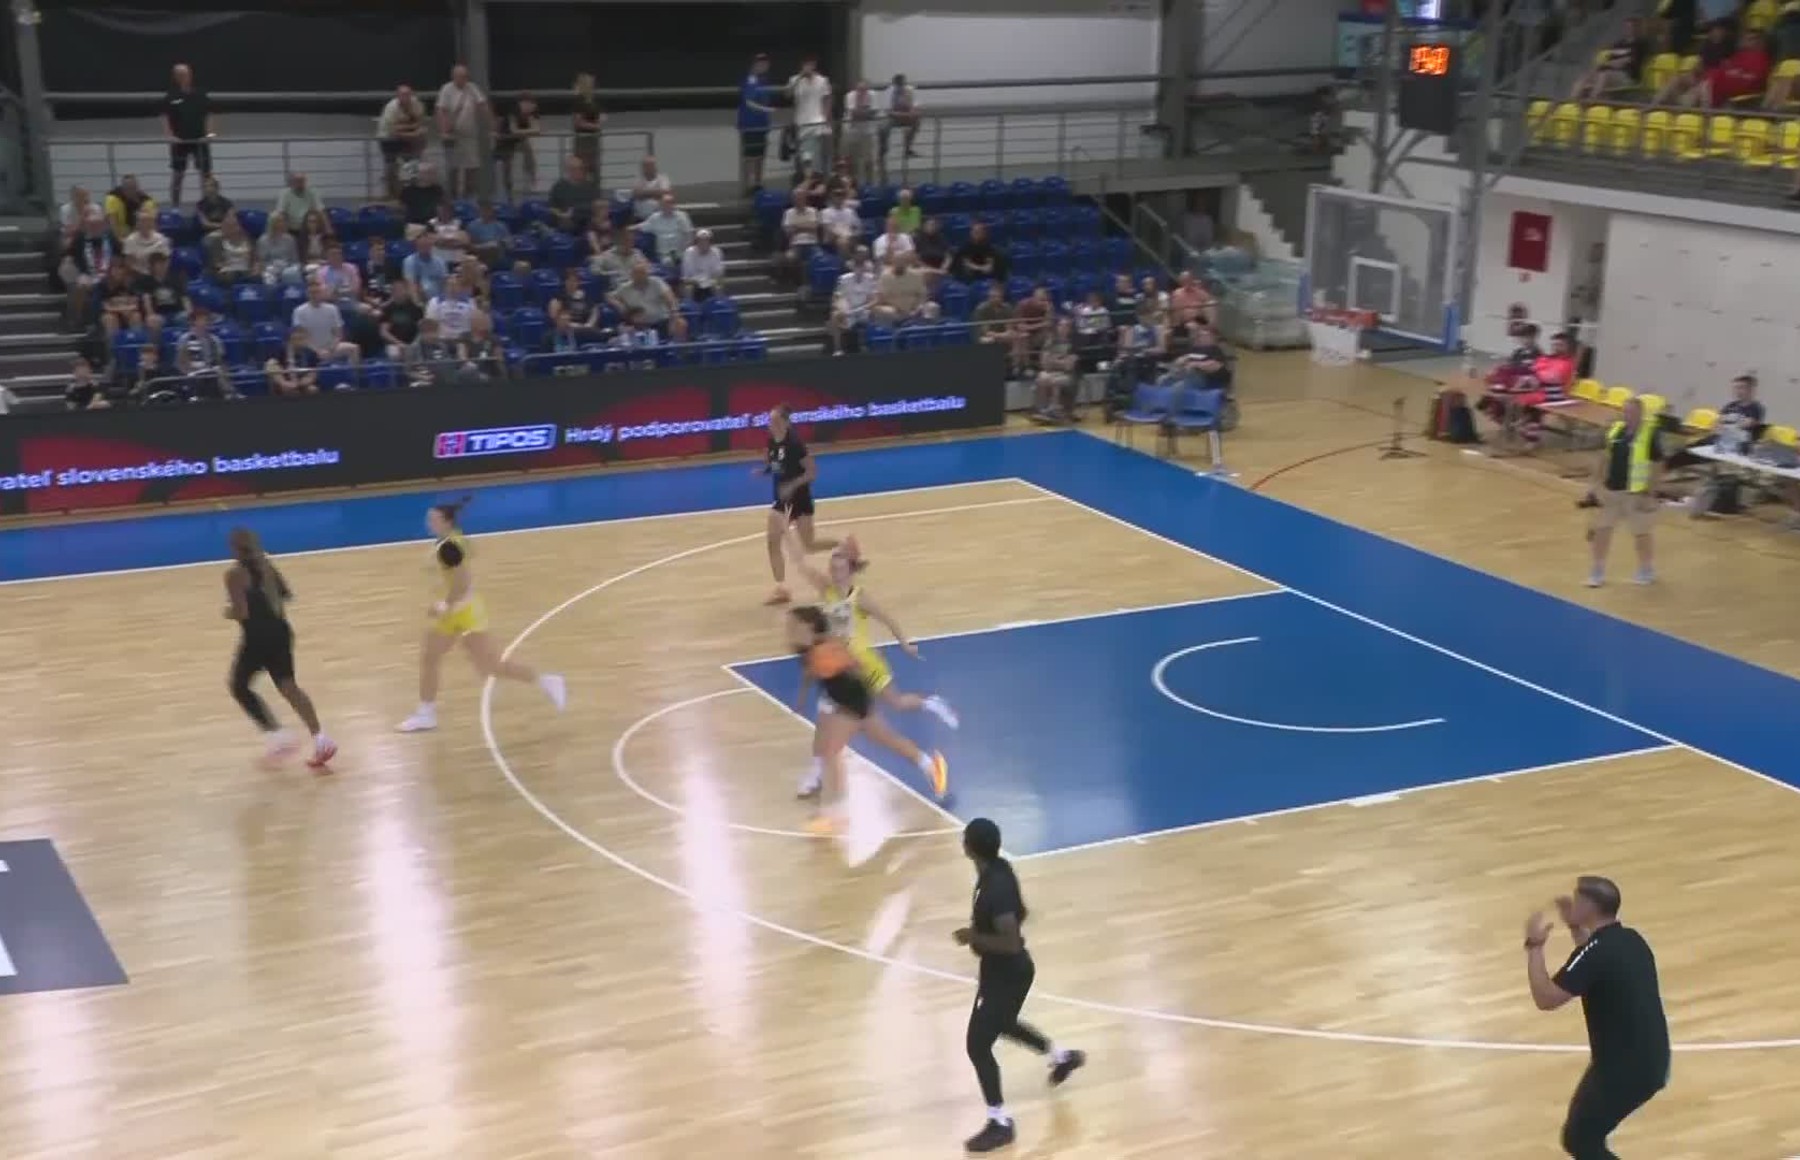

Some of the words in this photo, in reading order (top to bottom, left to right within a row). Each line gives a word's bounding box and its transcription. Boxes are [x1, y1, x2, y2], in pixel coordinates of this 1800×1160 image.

[565, 424, 614, 443] Hrdý
[617, 413, 750, 442] podporovateľ
[752, 404, 866, 427] slenského
[867, 396, 966, 417] basketbalu
[468, 429, 548, 451] TIPOS
[57, 460, 208, 486] slovenského
[212, 448, 340, 473] basketbalu
